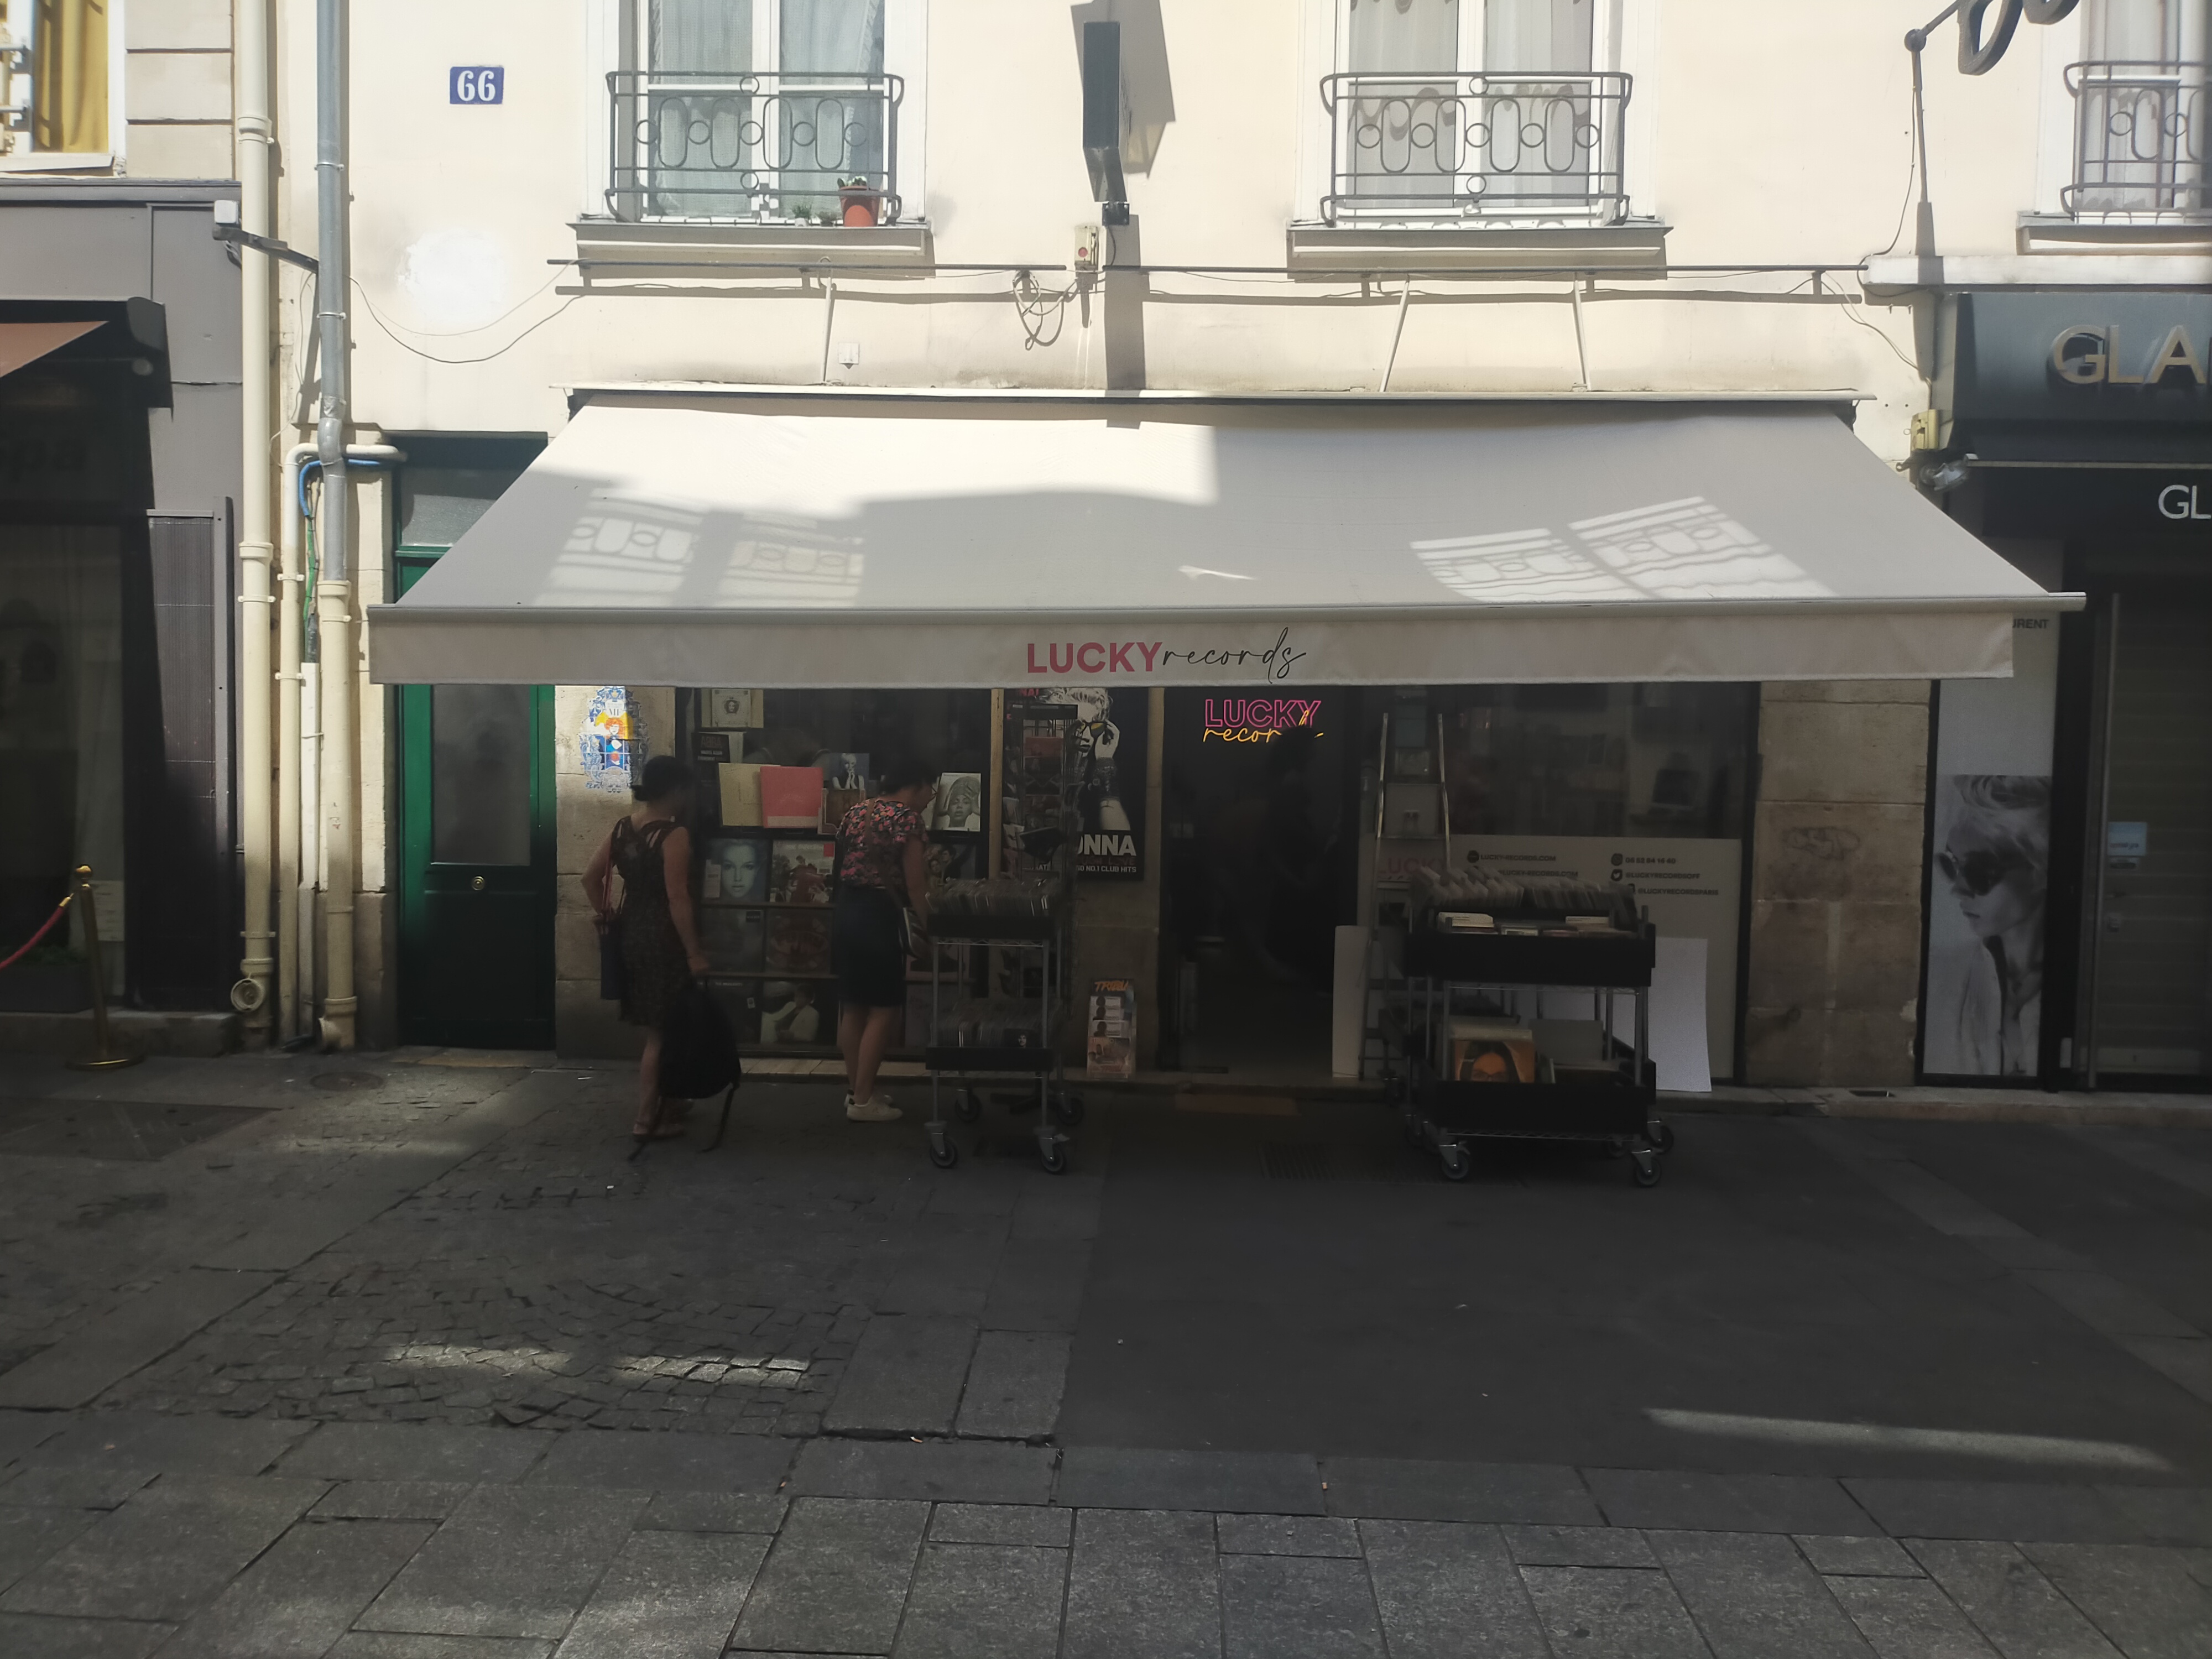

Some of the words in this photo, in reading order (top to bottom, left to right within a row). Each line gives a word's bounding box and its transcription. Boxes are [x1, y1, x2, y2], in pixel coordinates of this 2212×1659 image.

[457, 70, 495, 101] 66
[2052, 324, 2212, 384] GLA
[2158, 484, 2211, 520] GL
[1027, 641, 1162, 674] LUCKY
[1162, 627, 1307, 684] records
[1205, 698, 1322, 728] LUCKY
